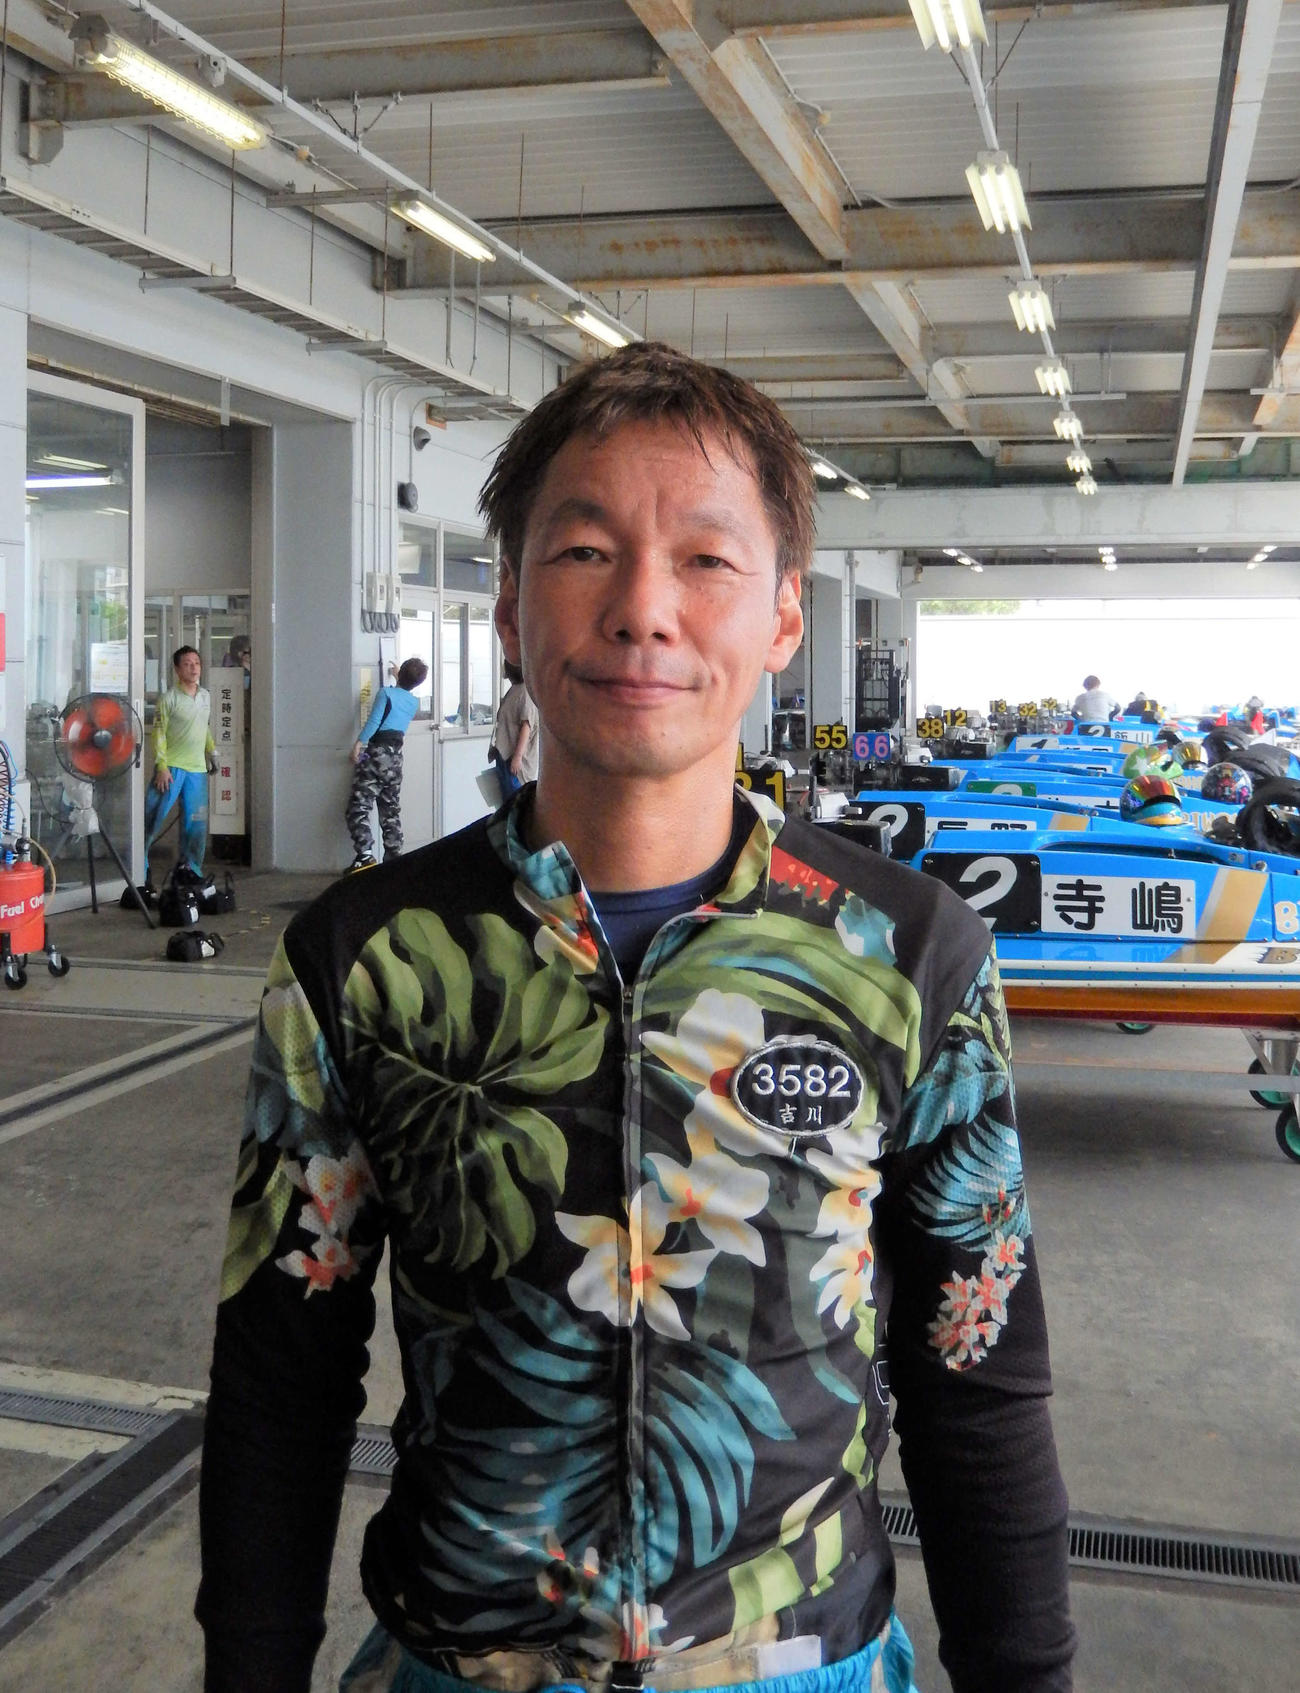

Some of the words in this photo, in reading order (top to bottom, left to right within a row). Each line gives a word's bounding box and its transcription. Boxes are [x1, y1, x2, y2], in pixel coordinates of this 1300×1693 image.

[221, 688, 232, 741] 定時定点
[945, 710, 967, 726] 12
[1019, 703, 1037, 717] 32
[814, 726, 847, 749] 55
[917, 718, 944, 738] 38
[855, 735, 889, 758] 66
[959, 856, 1018, 932] 2
[0, 901, 24, 919] Fuel
[1053, 878, 1184, 934] 寺嶋
[751, 1063, 851, 1098] 3582
[778, 1103, 823, 1125] 吉川
